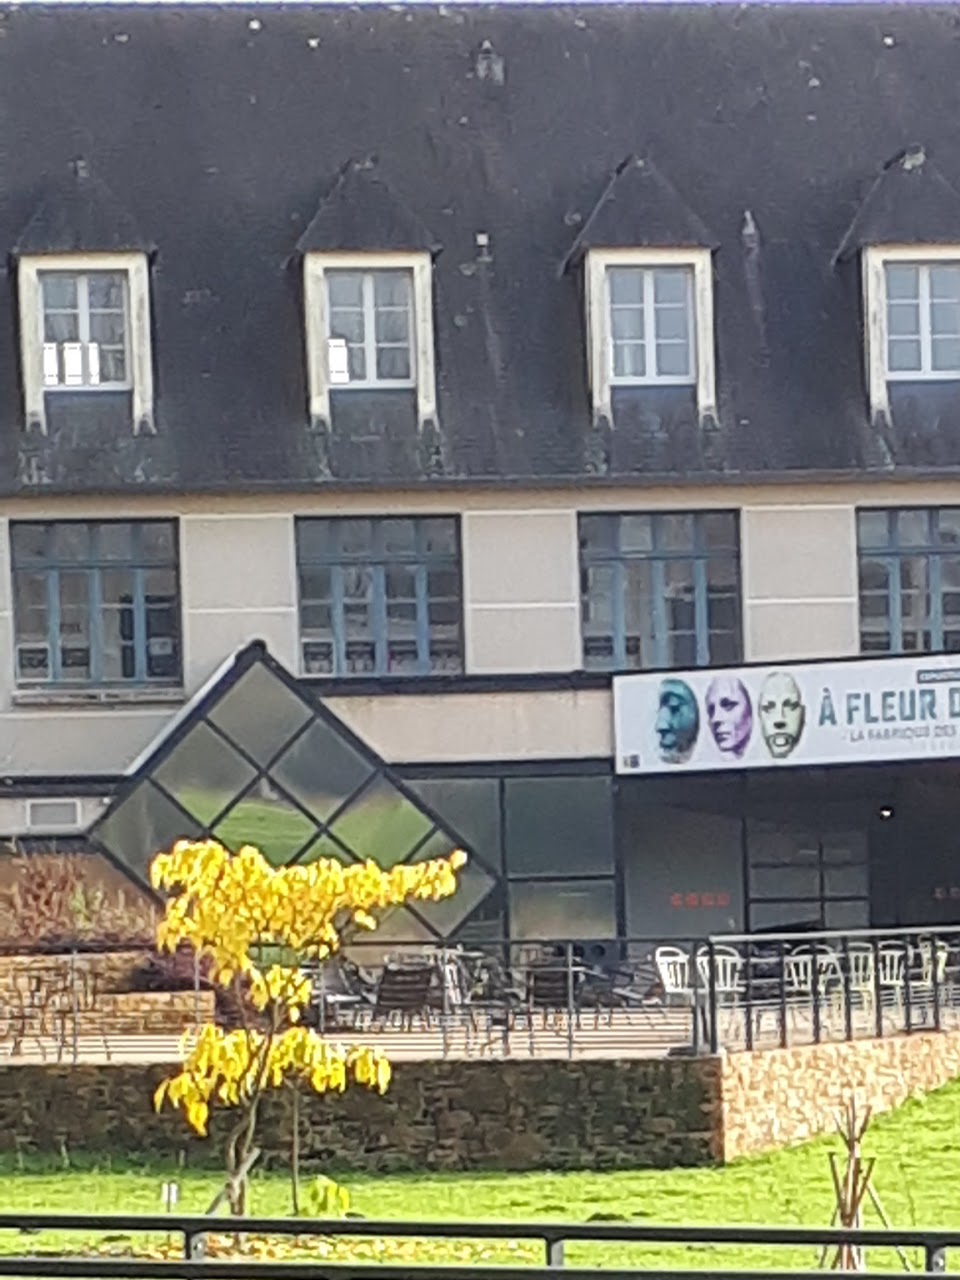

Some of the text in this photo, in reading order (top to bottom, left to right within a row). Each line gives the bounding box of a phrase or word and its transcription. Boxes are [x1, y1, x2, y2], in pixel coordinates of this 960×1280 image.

[818, 687, 837, 727] À
[846, 688, 937, 725] FLEUR
[850, 730, 865, 742] LA
[868, 726, 930, 741] FABRIQUE
